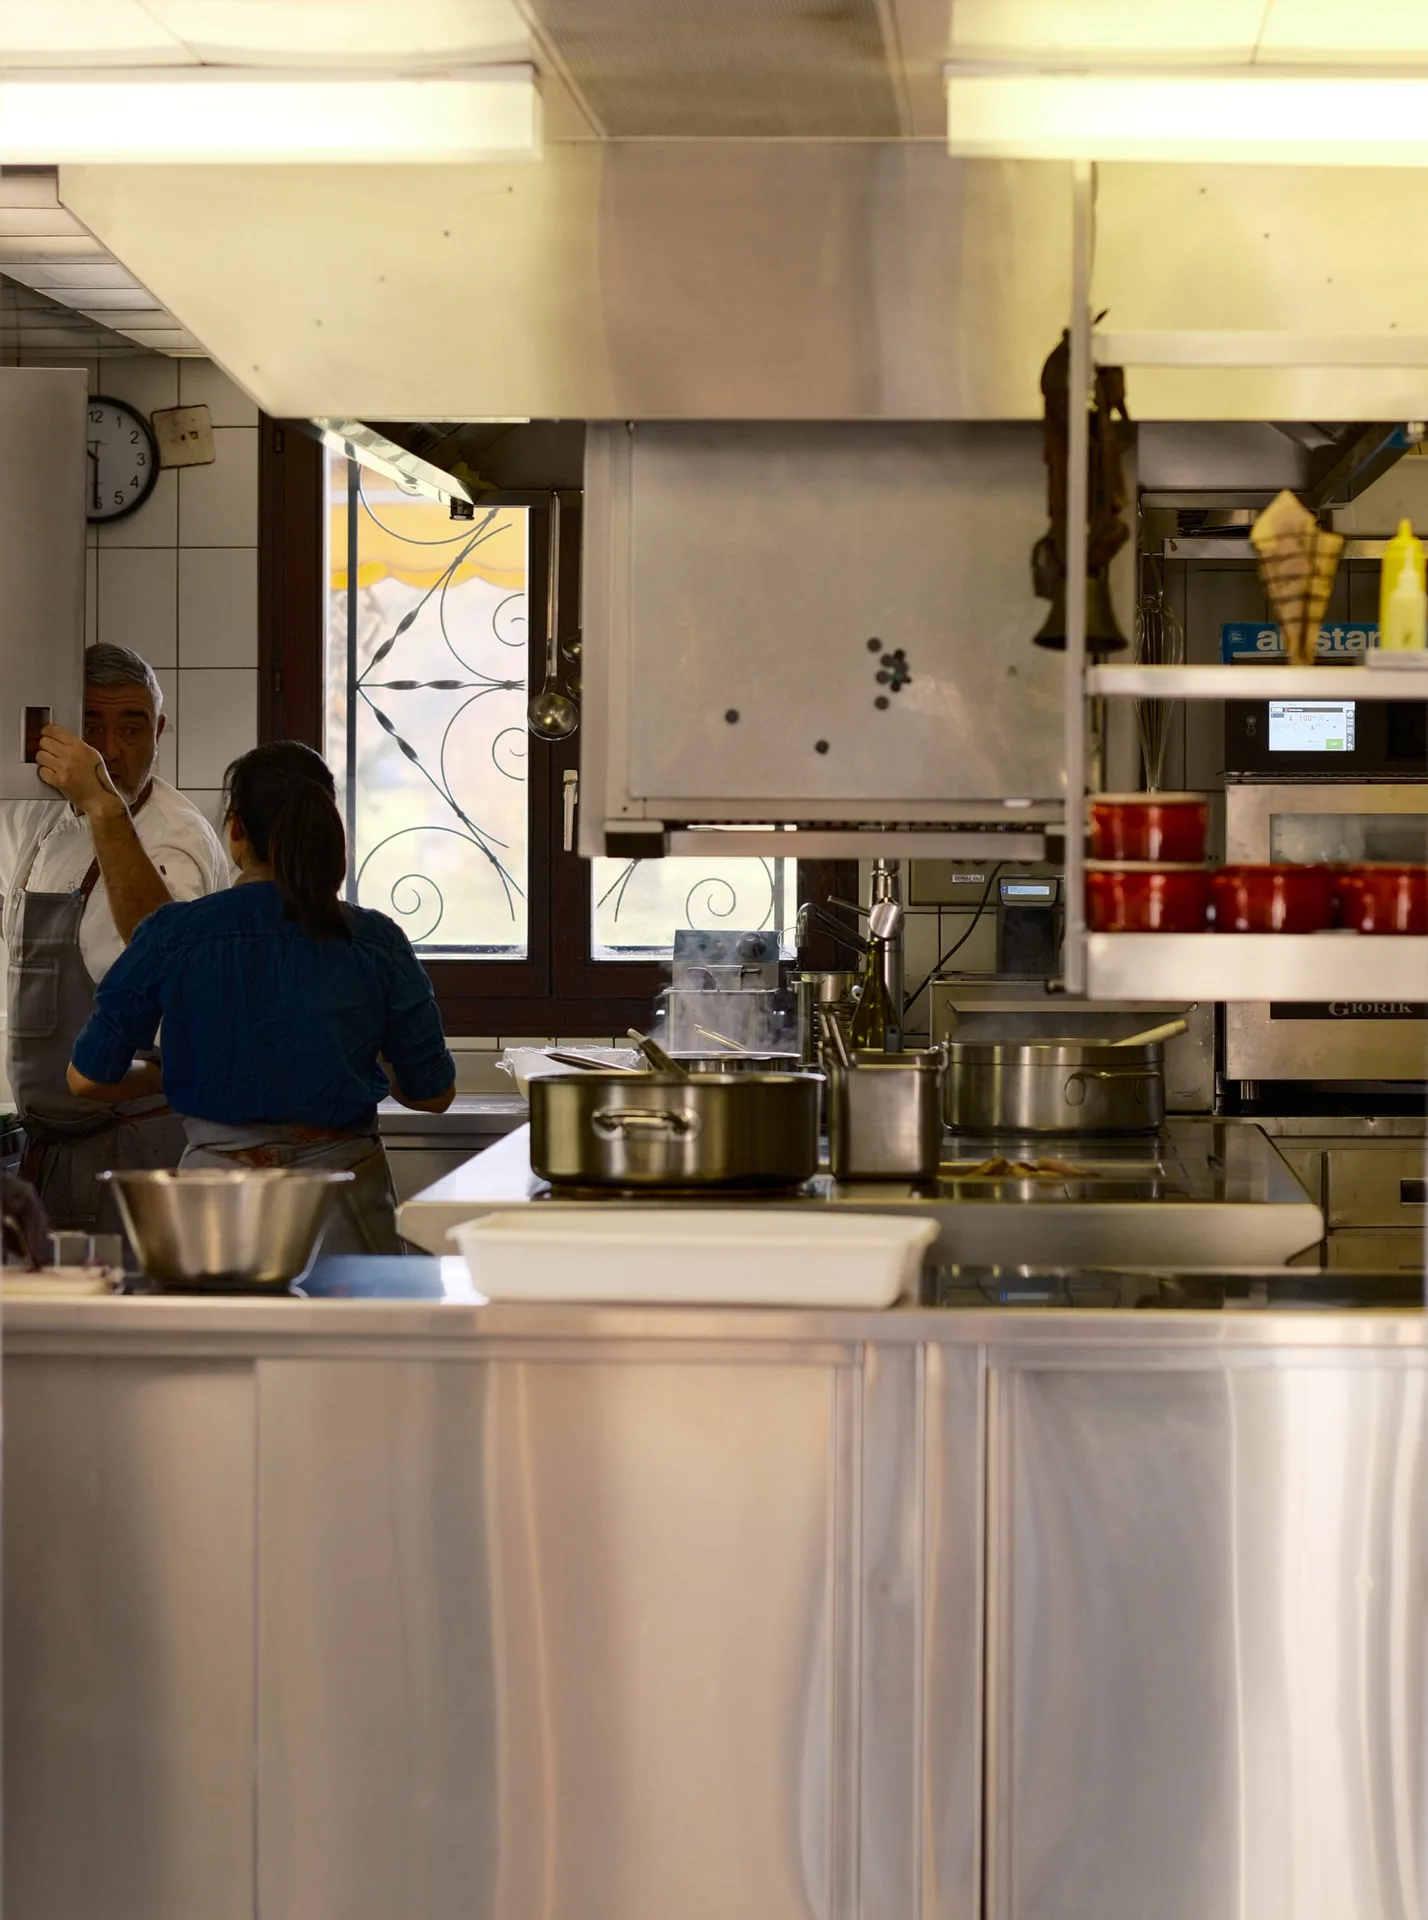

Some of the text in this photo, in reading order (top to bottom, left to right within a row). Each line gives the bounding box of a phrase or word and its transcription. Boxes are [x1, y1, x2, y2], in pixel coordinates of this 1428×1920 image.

[88, 409, 103, 423] 12
[115, 416, 122, 429] 1
[130, 431, 140, 444] 2
[137, 453, 146, 466] 3
[130, 476, 139, 488] 4
[114, 491, 124, 505] 5
